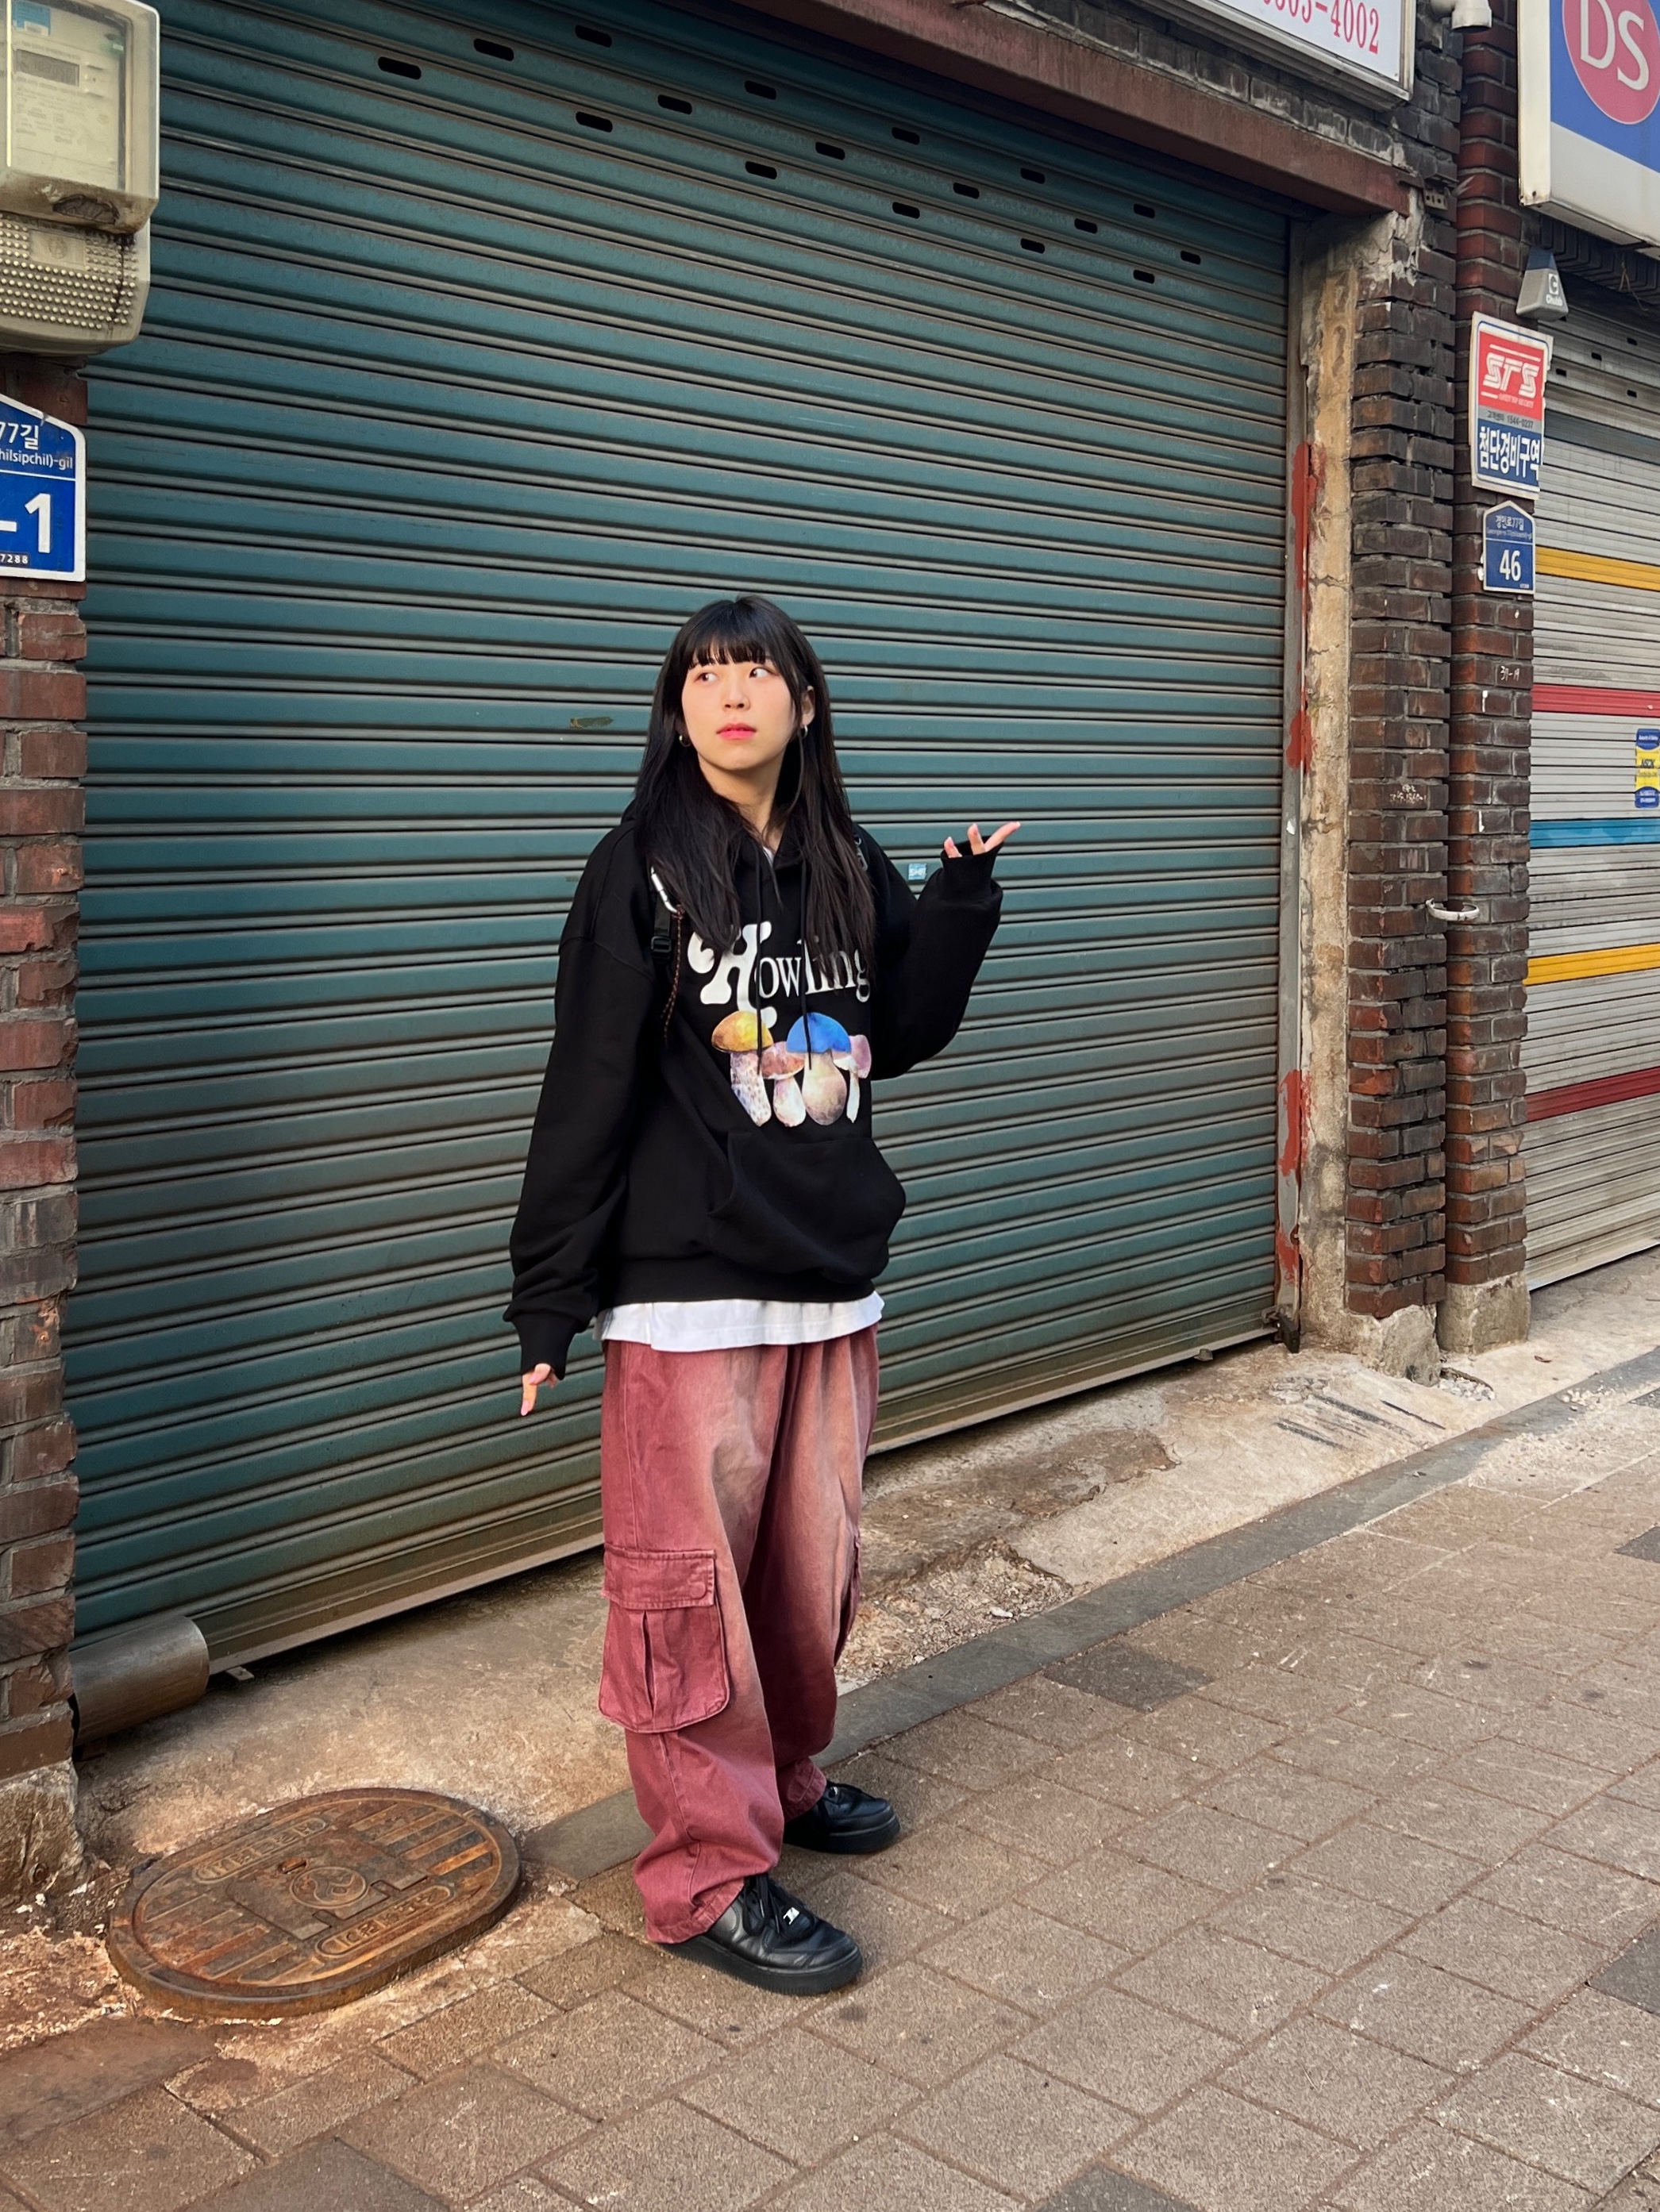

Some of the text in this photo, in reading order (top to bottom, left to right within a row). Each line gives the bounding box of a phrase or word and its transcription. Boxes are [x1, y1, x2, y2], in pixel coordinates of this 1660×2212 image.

[1581, 0, 1650, 90] DS
[1483, 352, 1539, 398] STS
[1479, 426, 1541, 481] 첨단경비구역
[1500, 549, 1521, 581] 46
[687, 921, 871, 1029] Howling
